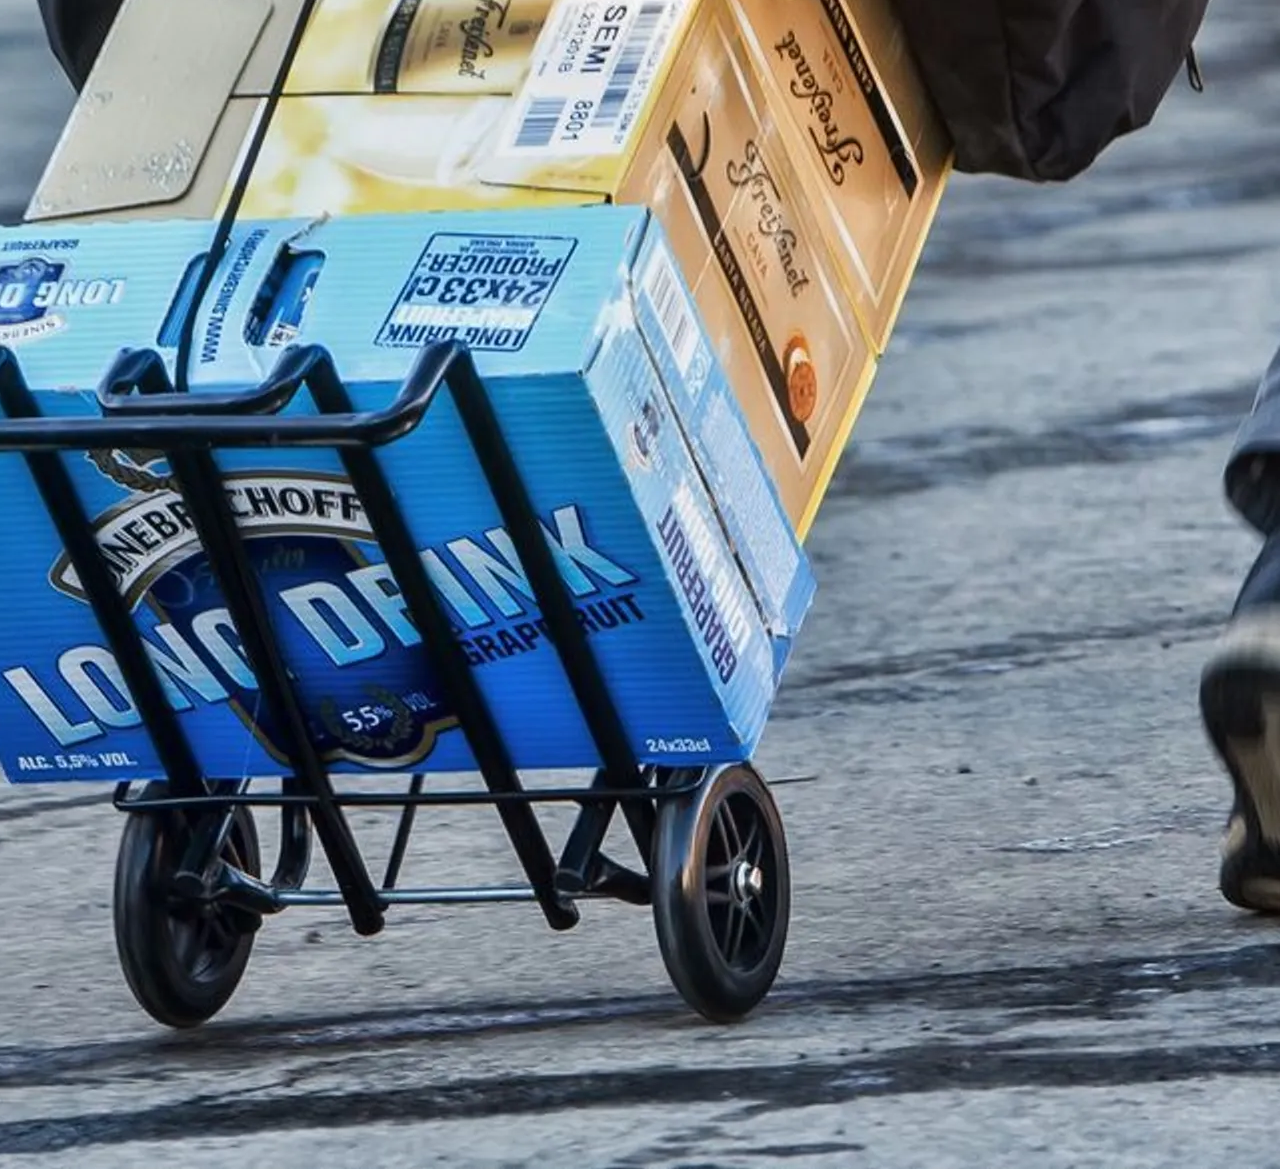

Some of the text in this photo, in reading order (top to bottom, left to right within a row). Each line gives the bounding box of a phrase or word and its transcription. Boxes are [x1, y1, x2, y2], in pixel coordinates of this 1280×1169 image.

[580, 4, 628, 74] SEMI
[560, 100, 594, 141] 8801
[774, 30, 864, 186] Freixenet
[726, 139, 811, 299] Freixenet
[1, 238, 80, 252] GRAPEFRUIT
[421, 252, 562, 277] PRODUCER:
[745, 233, 768, 279] CAVA
[34, 277, 127, 308] LONG
[464, 326, 526, 347] LONG
[656, 505, 738, 685] GRAPEFRUIT
[17, 752, 54, 770] ALC.
[99, 749, 138, 767] VOL.
